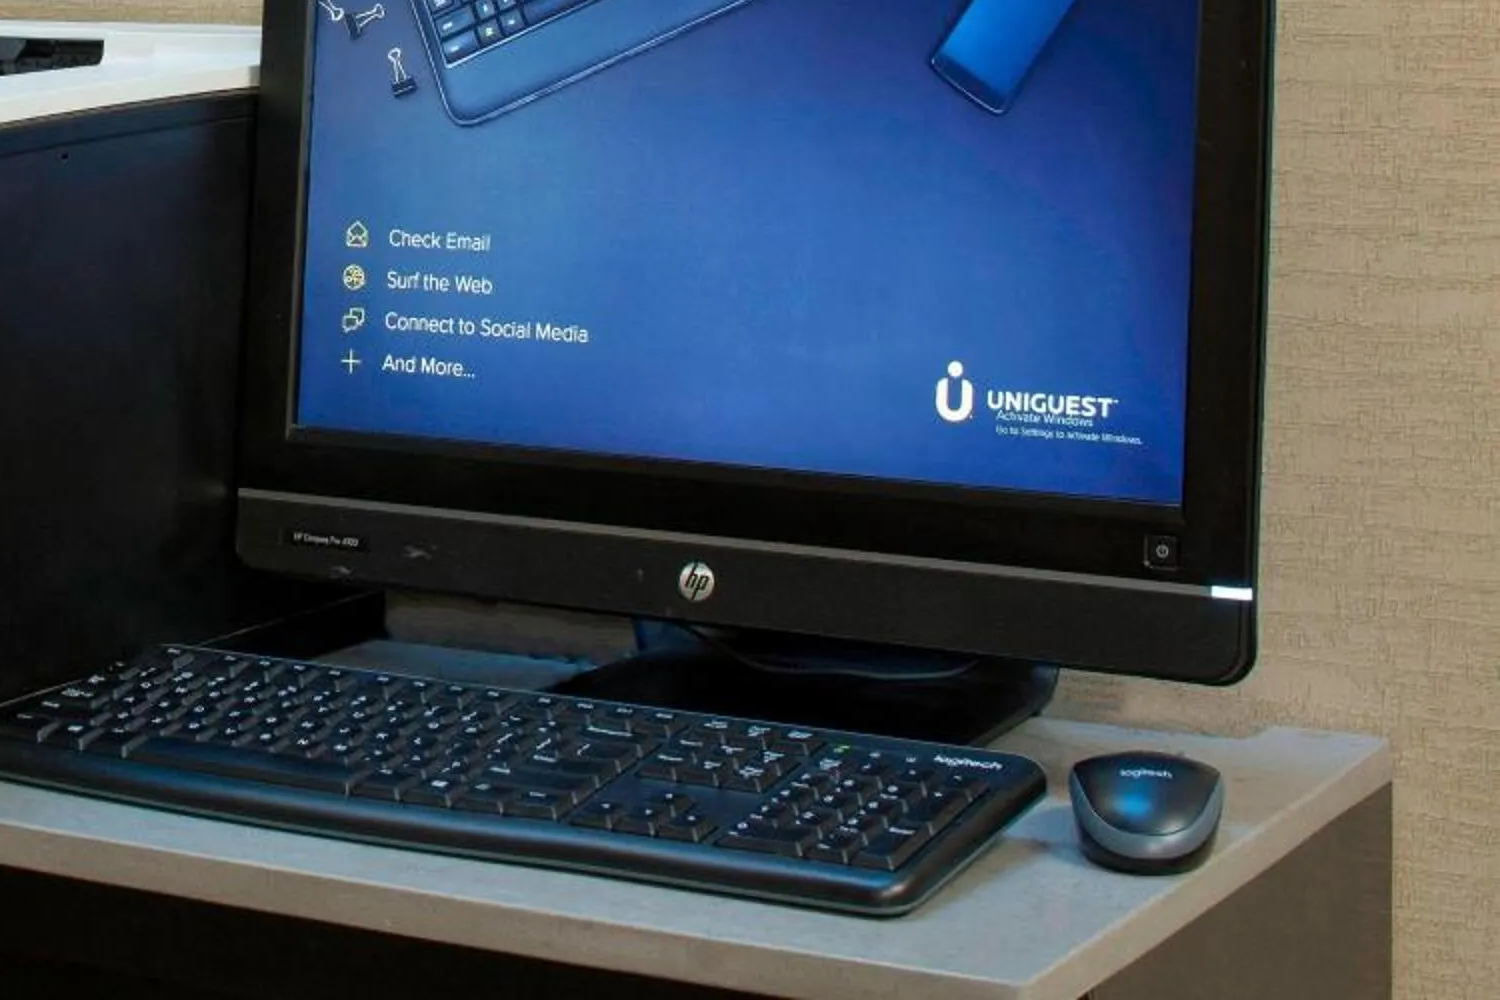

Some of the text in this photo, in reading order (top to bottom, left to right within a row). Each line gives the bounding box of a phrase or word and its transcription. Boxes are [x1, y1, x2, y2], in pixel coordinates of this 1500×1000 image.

[389, 229, 492, 252] Check Email
[387, 270, 493, 295] Surf the Web
[385, 311, 590, 343] Connect to Social Media
[381, 353, 416, 373] And
[996, 409, 1094, 427] Activate Windows
[682, 561, 712, 601] hp
